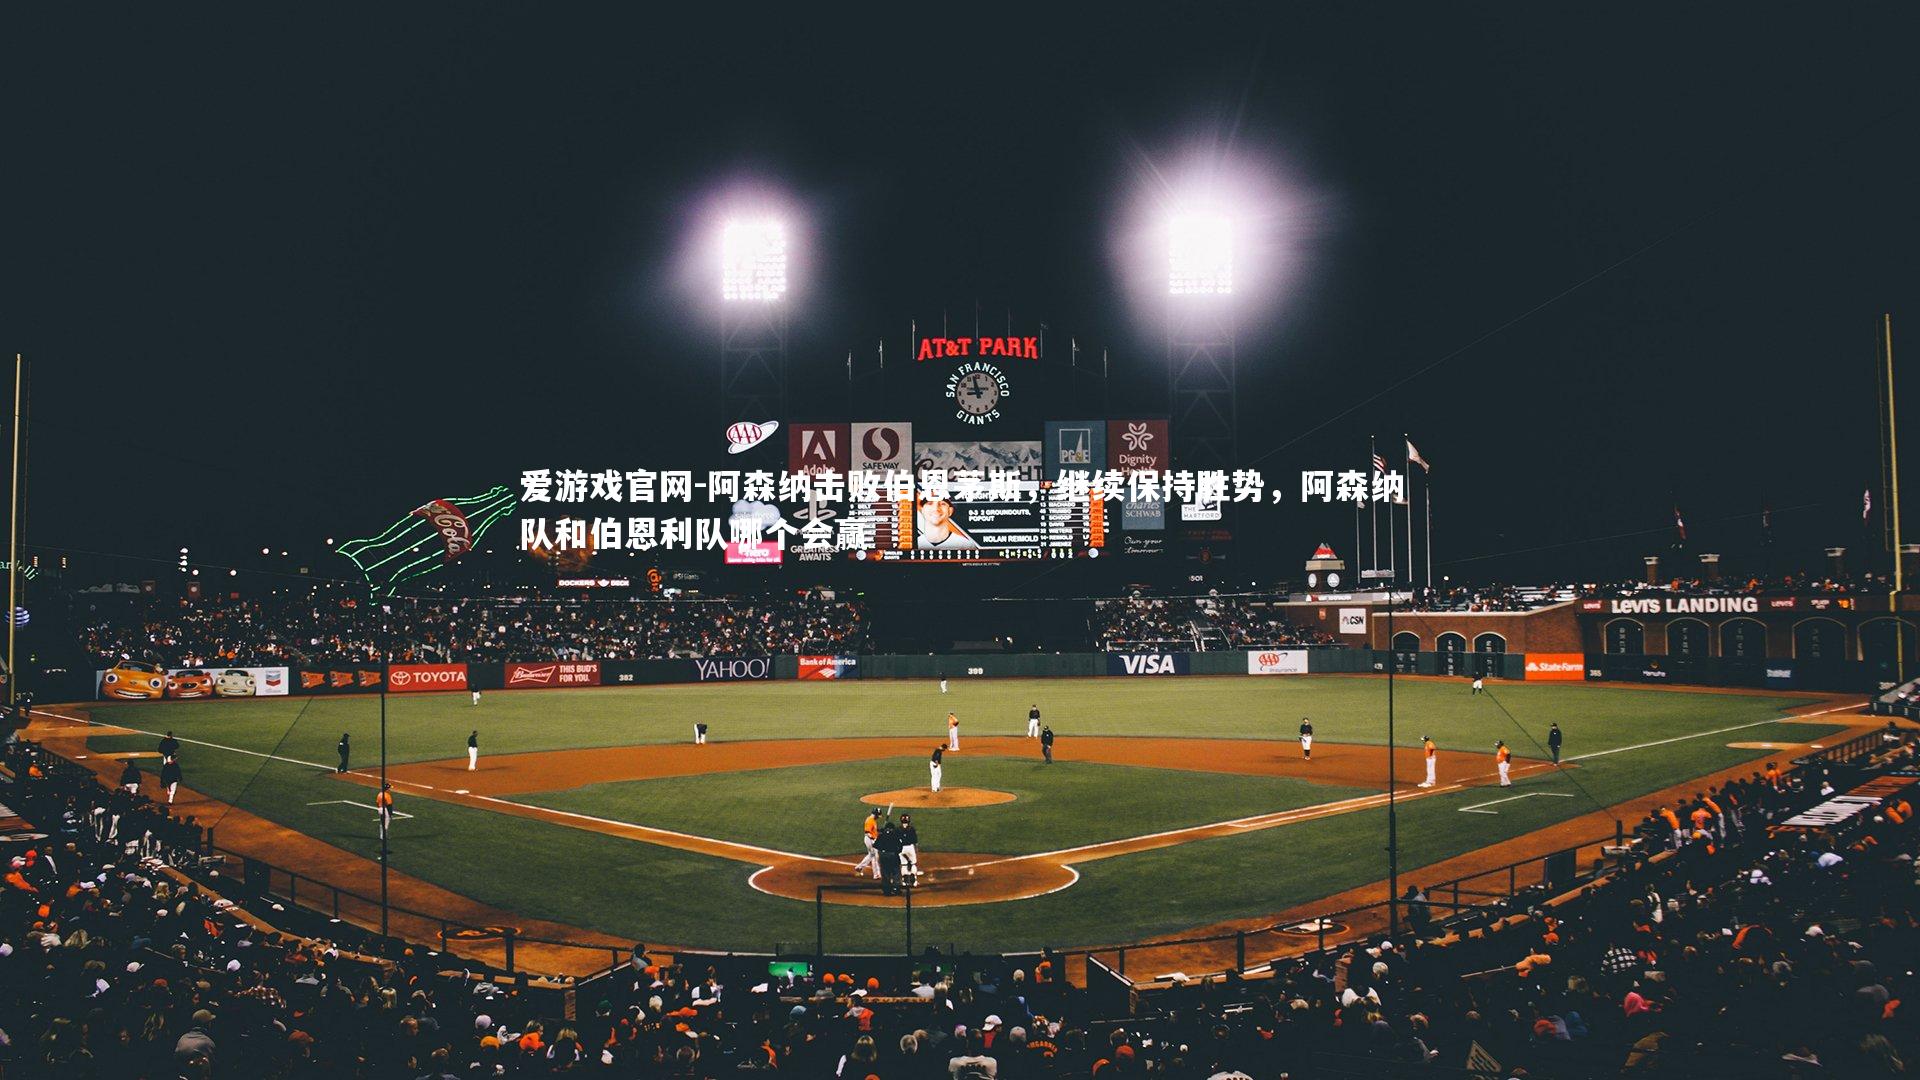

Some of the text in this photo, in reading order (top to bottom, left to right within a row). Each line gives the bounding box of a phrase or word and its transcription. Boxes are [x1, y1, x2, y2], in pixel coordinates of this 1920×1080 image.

[918, 337, 1038, 360] AT&T PARK
[945, 362, 1010, 398] SAN FRANCISCO
[956, 409, 1000, 425] GIANTS
[1061, 450, 1089, 462] PG&E
[1120, 455, 1157, 467] Dignity
[862, 462, 900, 470] SAFEWAY
[1126, 510, 1161, 518] SCHWAB
[1144, 539, 1162, 548] your
[800, 553, 831, 561] AWAITS
[558, 579, 596, 587] DOCKERS
[1666, 597, 1758, 614] LANDING
[1349, 616, 1364, 625] CSN
[799, 658, 857, 666] Bank of America
[1119, 654, 1176, 675] VISA
[559, 664, 598, 673] THIS BUD'S
[695, 658, 771, 681] YAHOO!
[967, 667, 984, 676] 399
[413, 671, 467, 683] TOYOTA
[515, 669, 553, 680] Budweiser
[559, 674, 590, 682] FOR YOU.
[618, 674, 634, 682] 382
